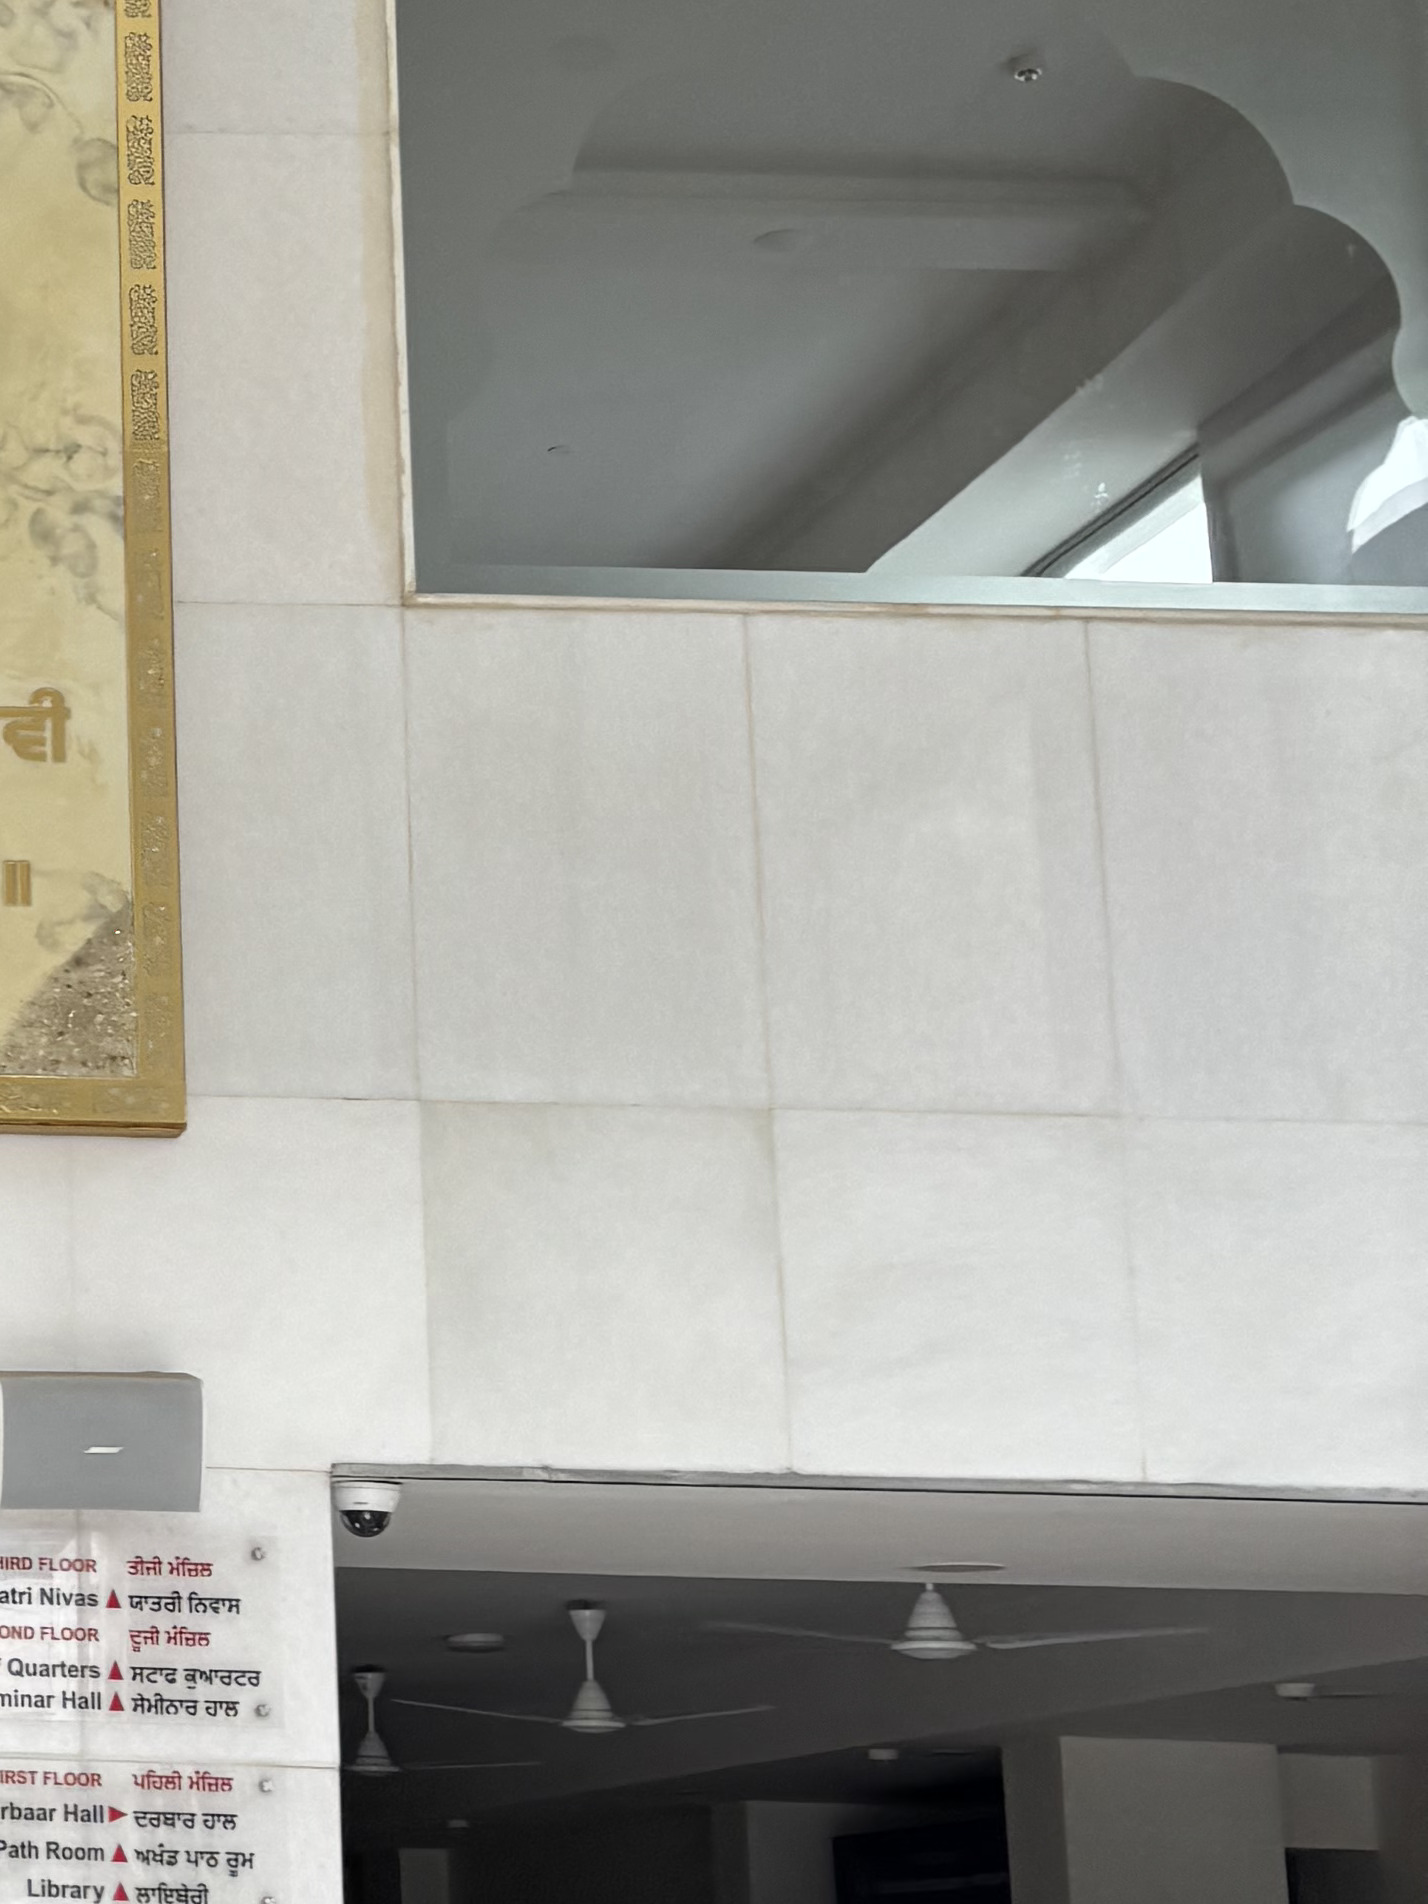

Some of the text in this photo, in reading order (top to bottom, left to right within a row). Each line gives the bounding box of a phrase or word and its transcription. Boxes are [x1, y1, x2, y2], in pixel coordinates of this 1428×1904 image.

[38, 1557, 96, 1572] FLOOR
[40, 1588, 98, 1607] Nivas
[40, 1627, 99, 1642] FLOOR
[7, 1658, 101, 1679] Quarters
[62, 1691, 101, 1710] Hall
[43, 1772, 102, 1787] FLOOR
[64, 1804, 104, 1823] Hall
[46, 1841, 104, 1861] Room
[27, 1879, 104, 1904] Library
